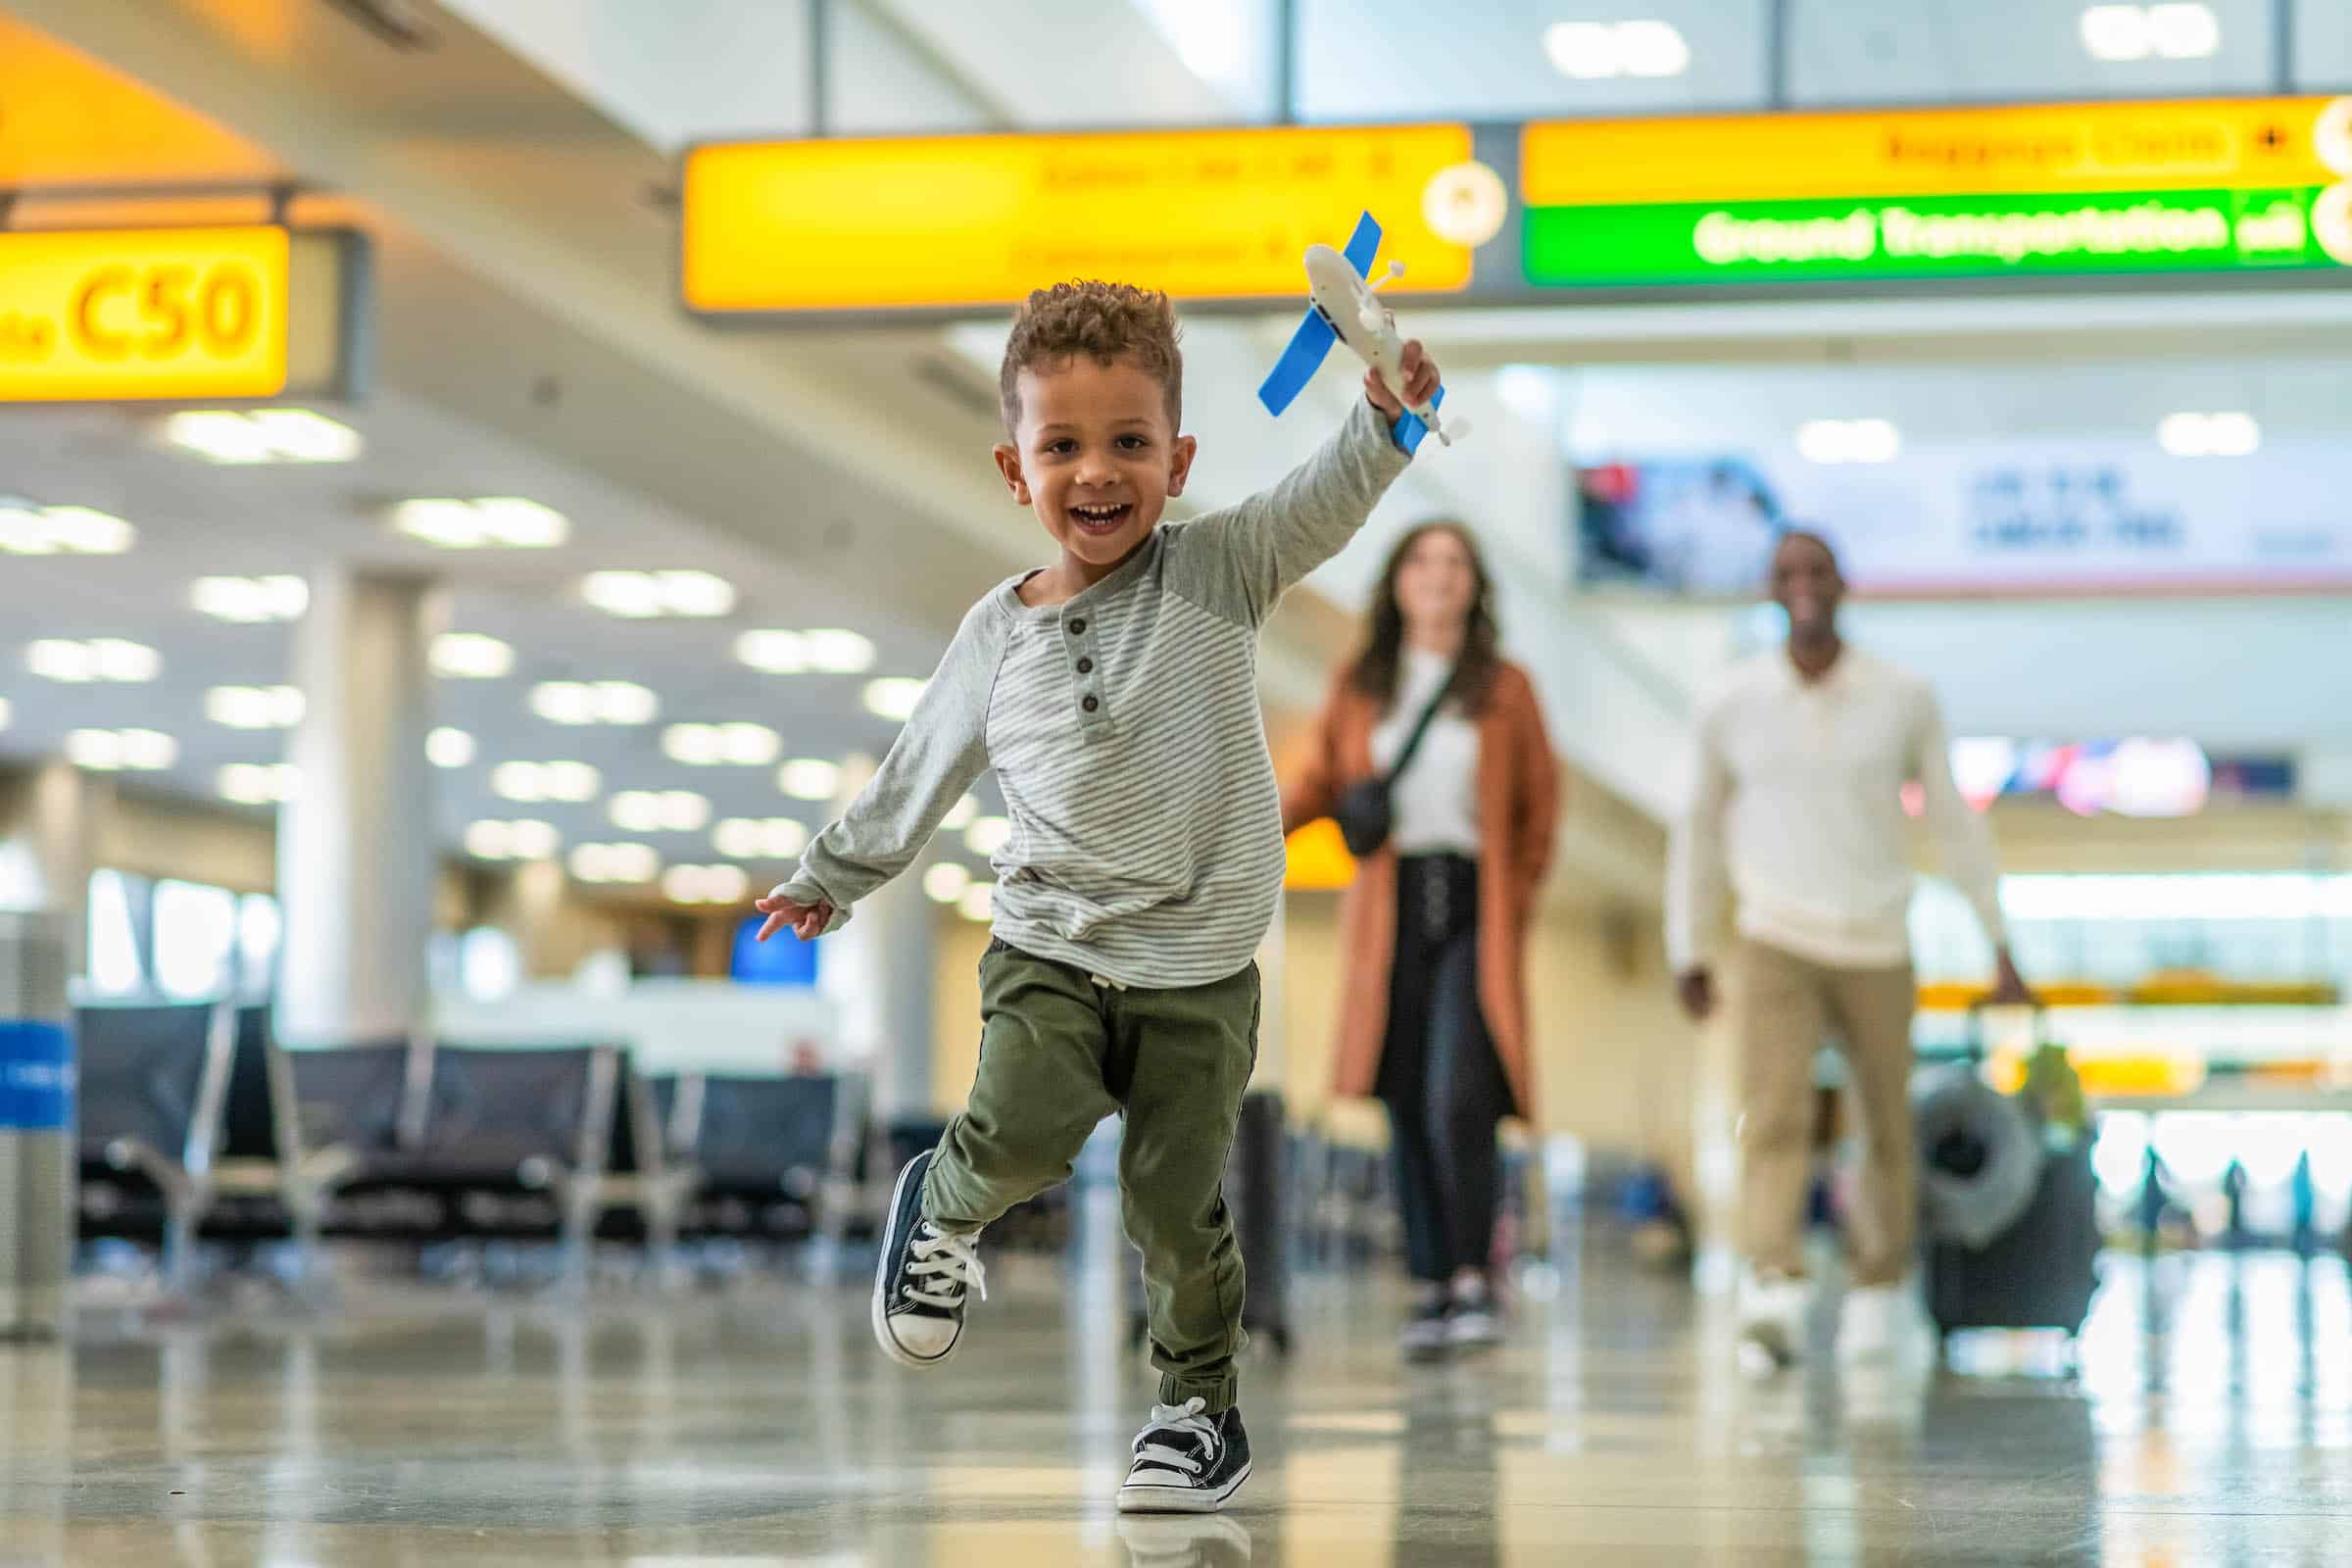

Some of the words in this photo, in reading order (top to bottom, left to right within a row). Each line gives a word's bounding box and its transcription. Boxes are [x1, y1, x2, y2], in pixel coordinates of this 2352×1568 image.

[1692, 208, 1876, 264] Ground
[1881, 201, 2229, 263] Transportation
[69, 262, 263, 361] C50
